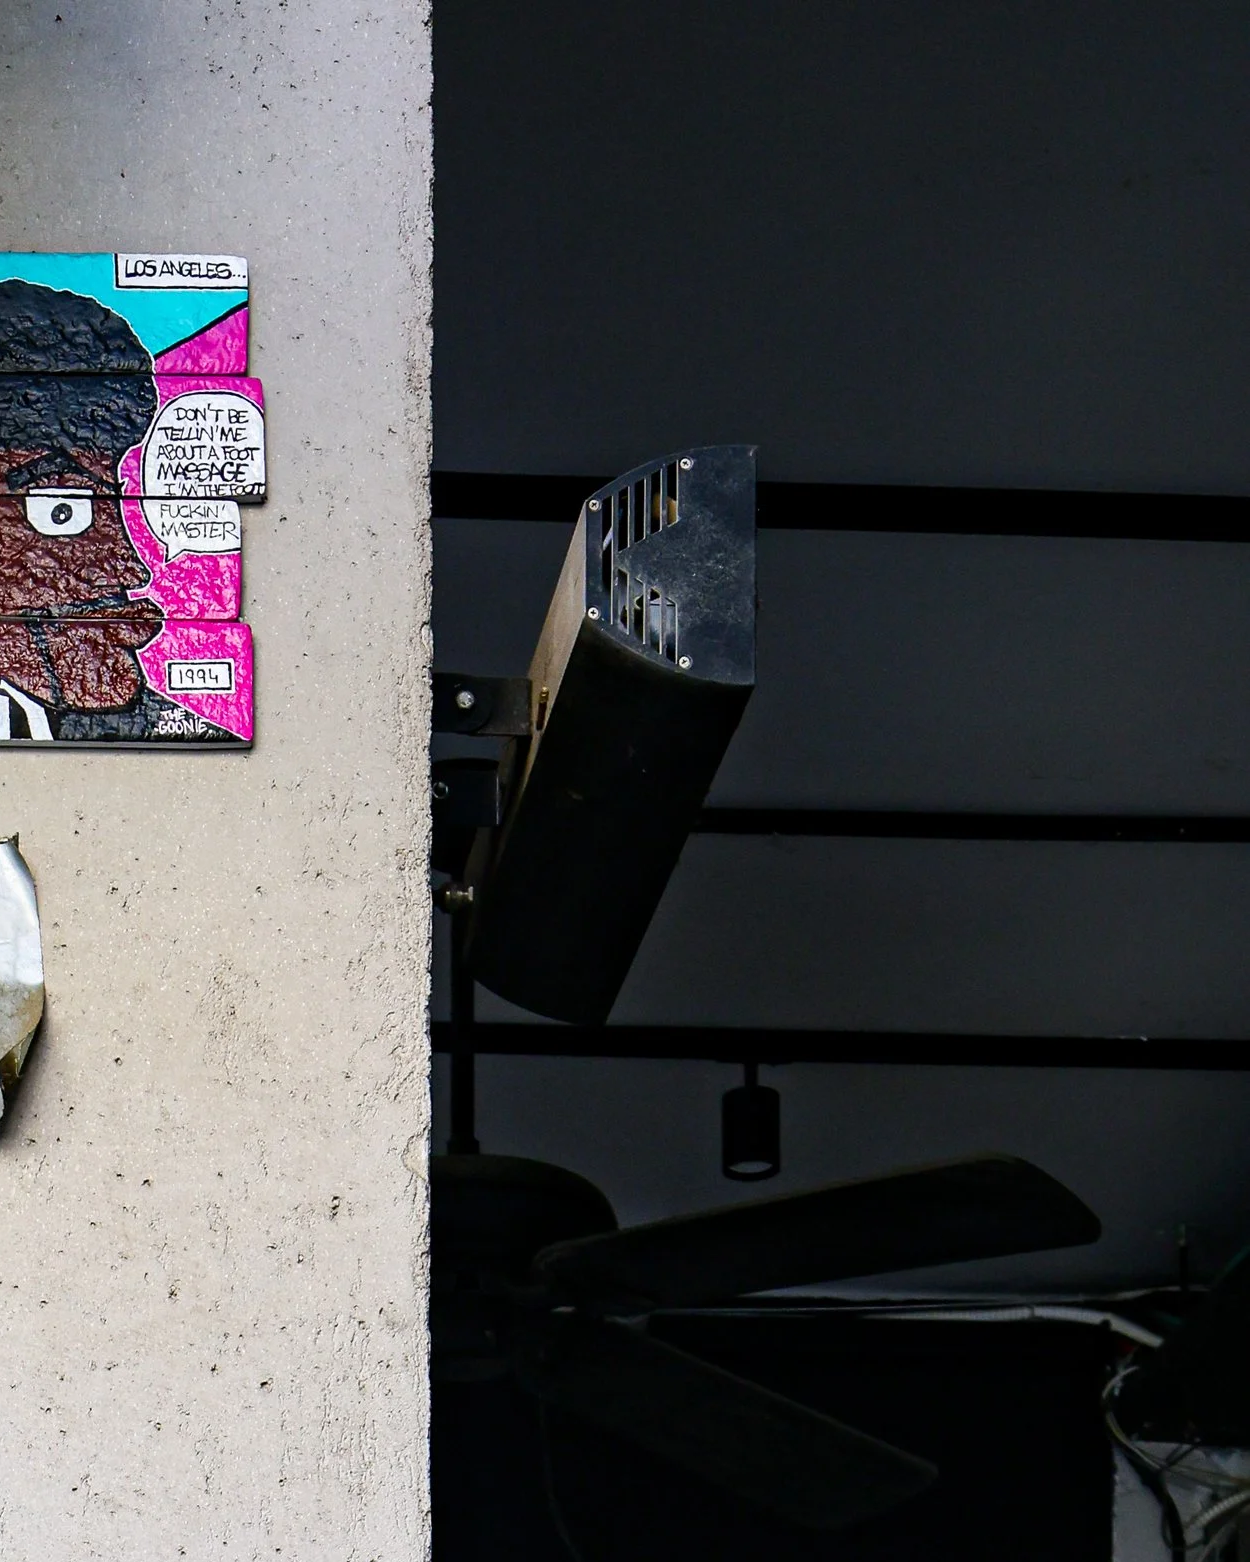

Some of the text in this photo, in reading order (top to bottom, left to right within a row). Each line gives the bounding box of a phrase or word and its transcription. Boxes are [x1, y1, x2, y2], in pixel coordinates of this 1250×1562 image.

[125, 259, 157, 278] LOS
[173, 403, 249, 424] DON'T BE
[220, 426, 247, 442] ME
[157, 444, 260, 461] ABOUT A FOOT
[157, 461, 249, 482] MASSAGE
[164, 482, 198, 497] I'M
[198, 483, 227, 496] THE
[160, 521, 240, 541] MASTER
[179, 668, 218, 684] 1994
[159, 708, 186, 721] THE
